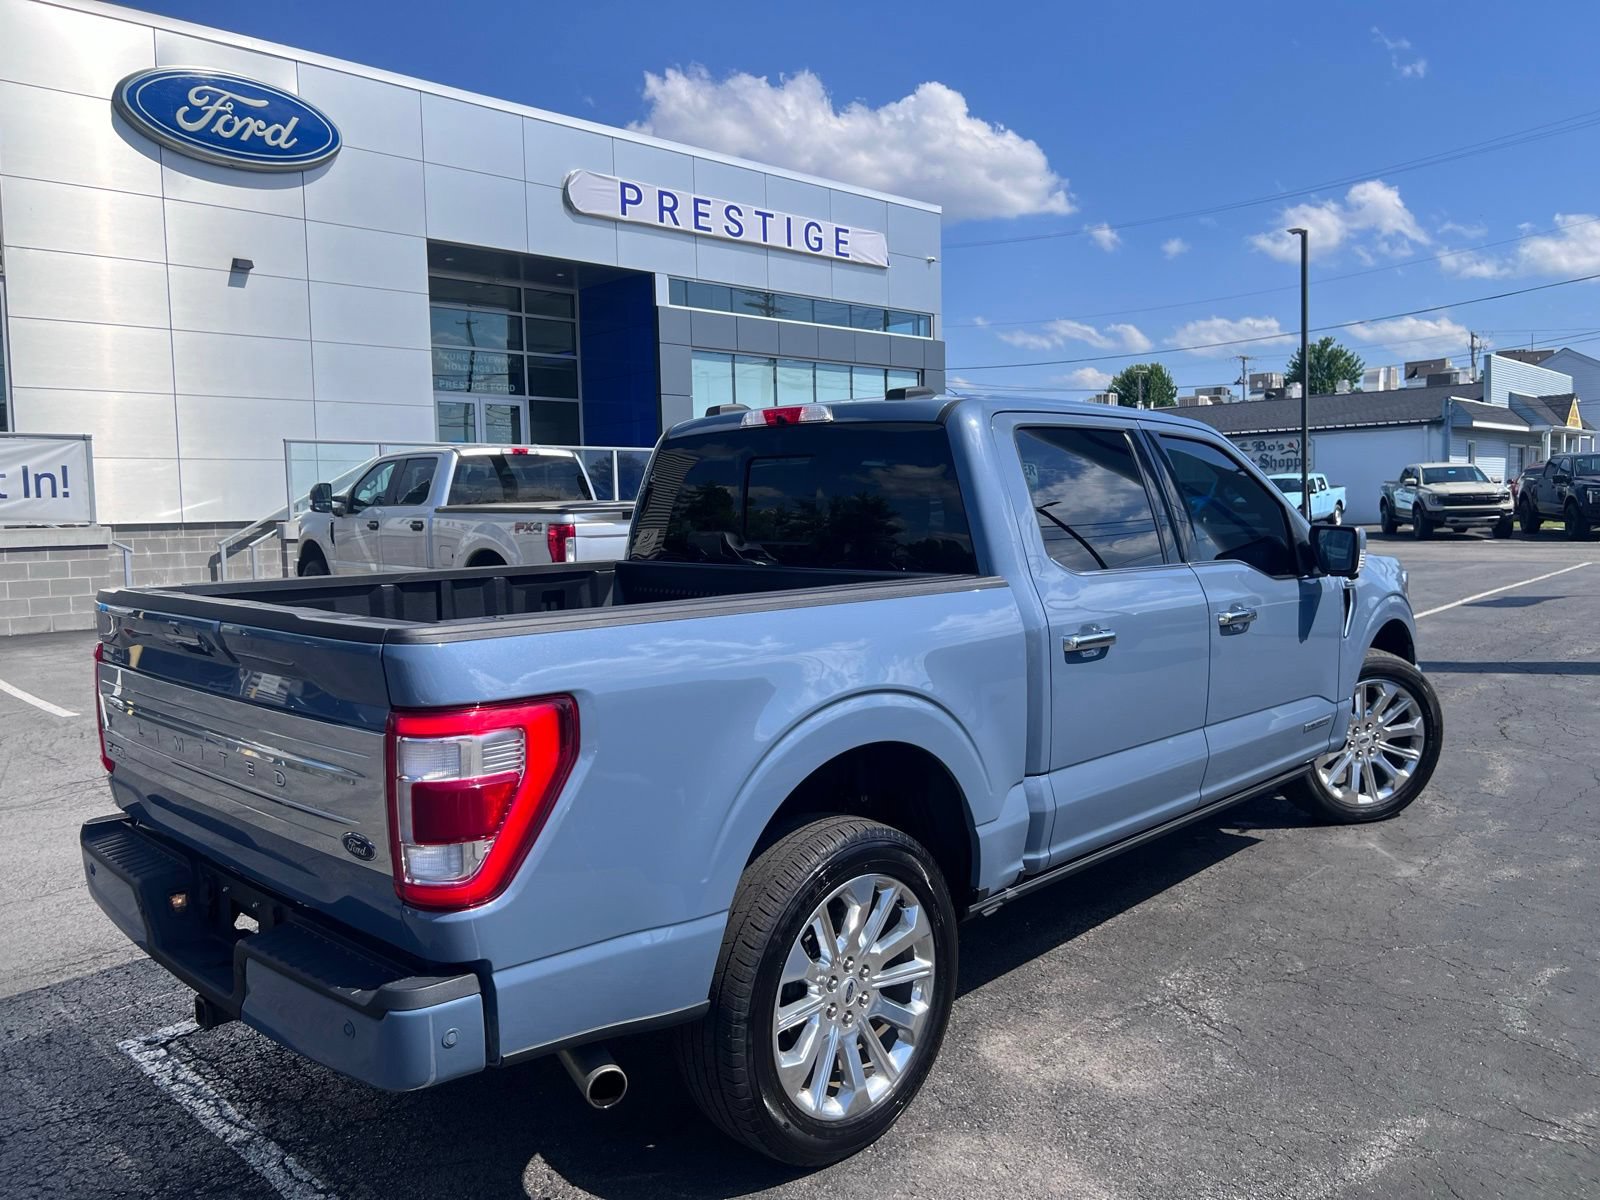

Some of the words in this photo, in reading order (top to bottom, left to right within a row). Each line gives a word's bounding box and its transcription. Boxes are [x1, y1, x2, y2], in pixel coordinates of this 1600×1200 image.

[175, 85, 300, 149] Ford
[618, 181, 851, 259] PRESTIGE
[438, 379, 488, 391] PRESTIGE
[490, 382, 516, 393] FORD
[1259, 453, 1312, 471] Shopp
[21, 465, 70, 499] In!
[514, 522, 543, 534] FX4
[137, 721, 287, 788] LIMITED
